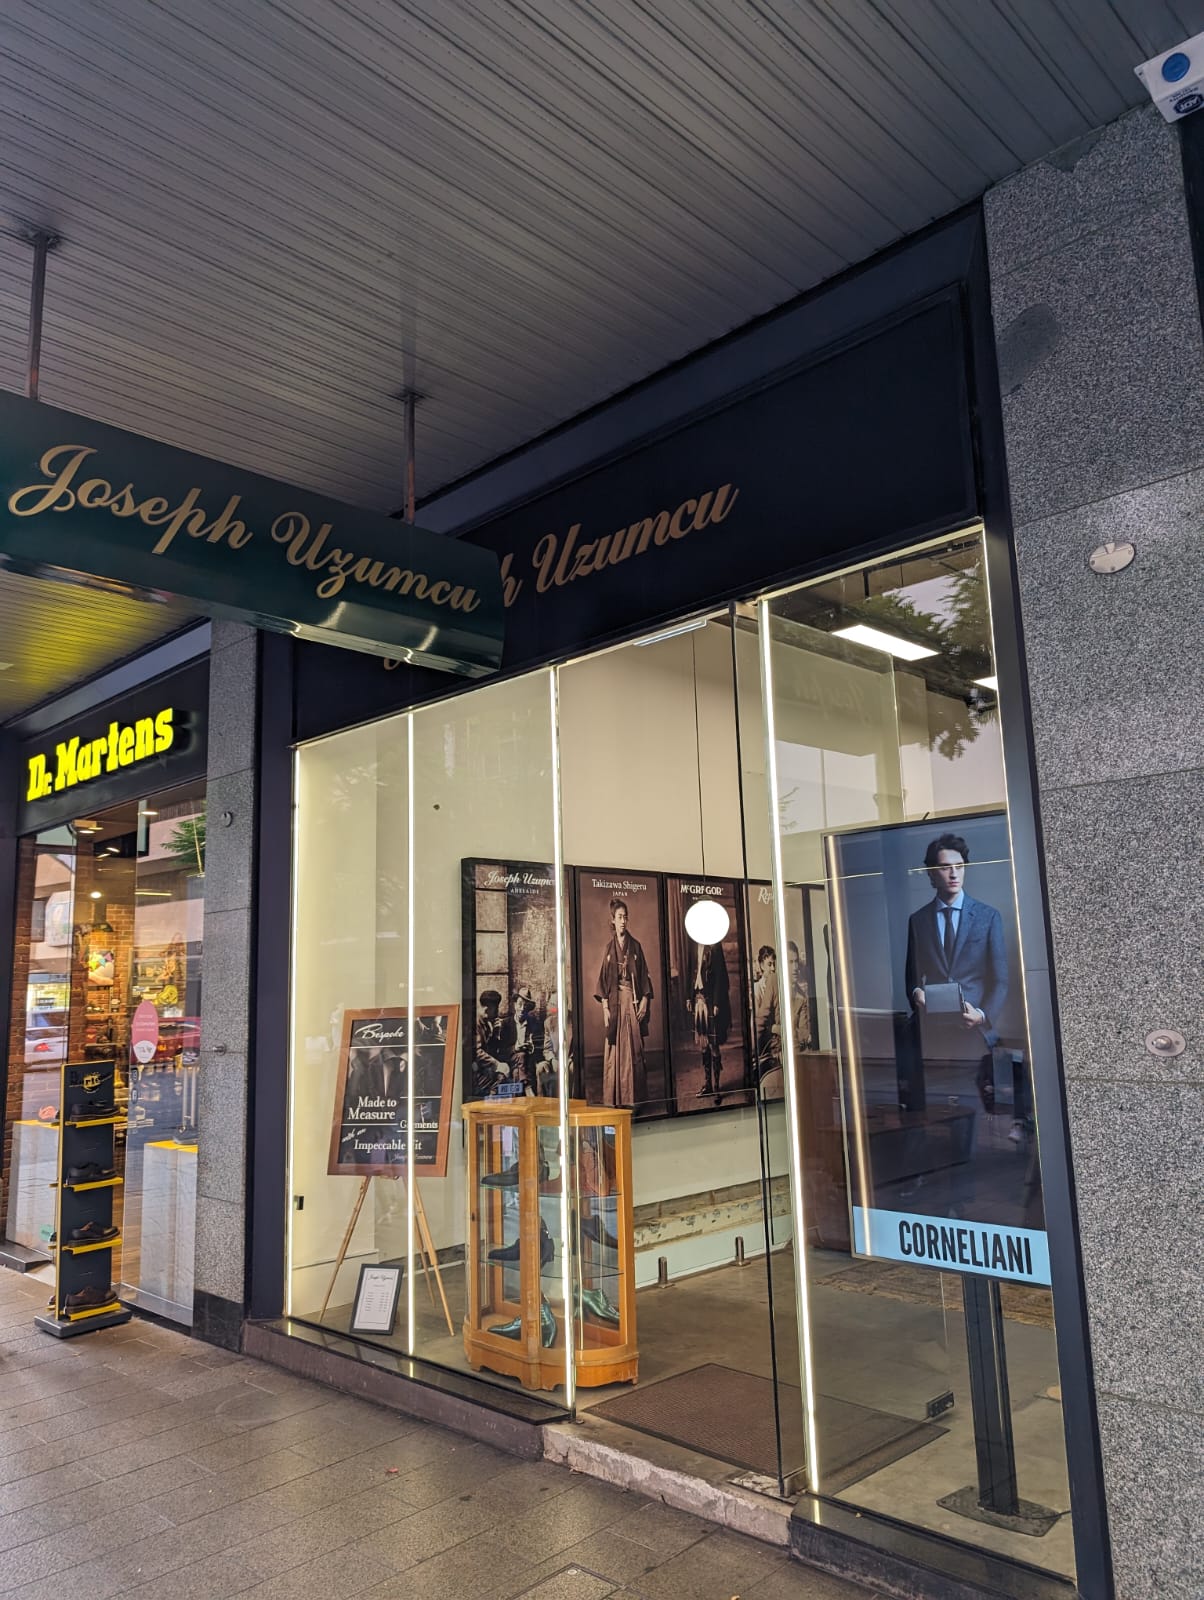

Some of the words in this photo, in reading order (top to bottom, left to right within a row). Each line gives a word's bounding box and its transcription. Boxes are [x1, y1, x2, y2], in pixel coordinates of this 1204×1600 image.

[9, 444, 253, 554] Joseph
[271, 511, 482, 613] Uzumcu
[532, 484, 740, 592] Uzumcu
[55, 708, 174, 791] Martens
[484, 871, 519, 887] Joseph
[522, 872, 554, 888] Uzumc
[592, 879, 622, 889] Takizawa
[622, 881, 647, 893] Shigeru
[354, 1023, 405, 1043] Bespoke
[358, 1096, 385, 1108] Made
[387, 1099, 397, 1107] to
[347, 1107, 396, 1120] Measure
[400, 1119, 438, 1129] Gments
[353, 1139, 406, 1154] Impeccable
[899, 1220, 1033, 1276] CORNELIANI
